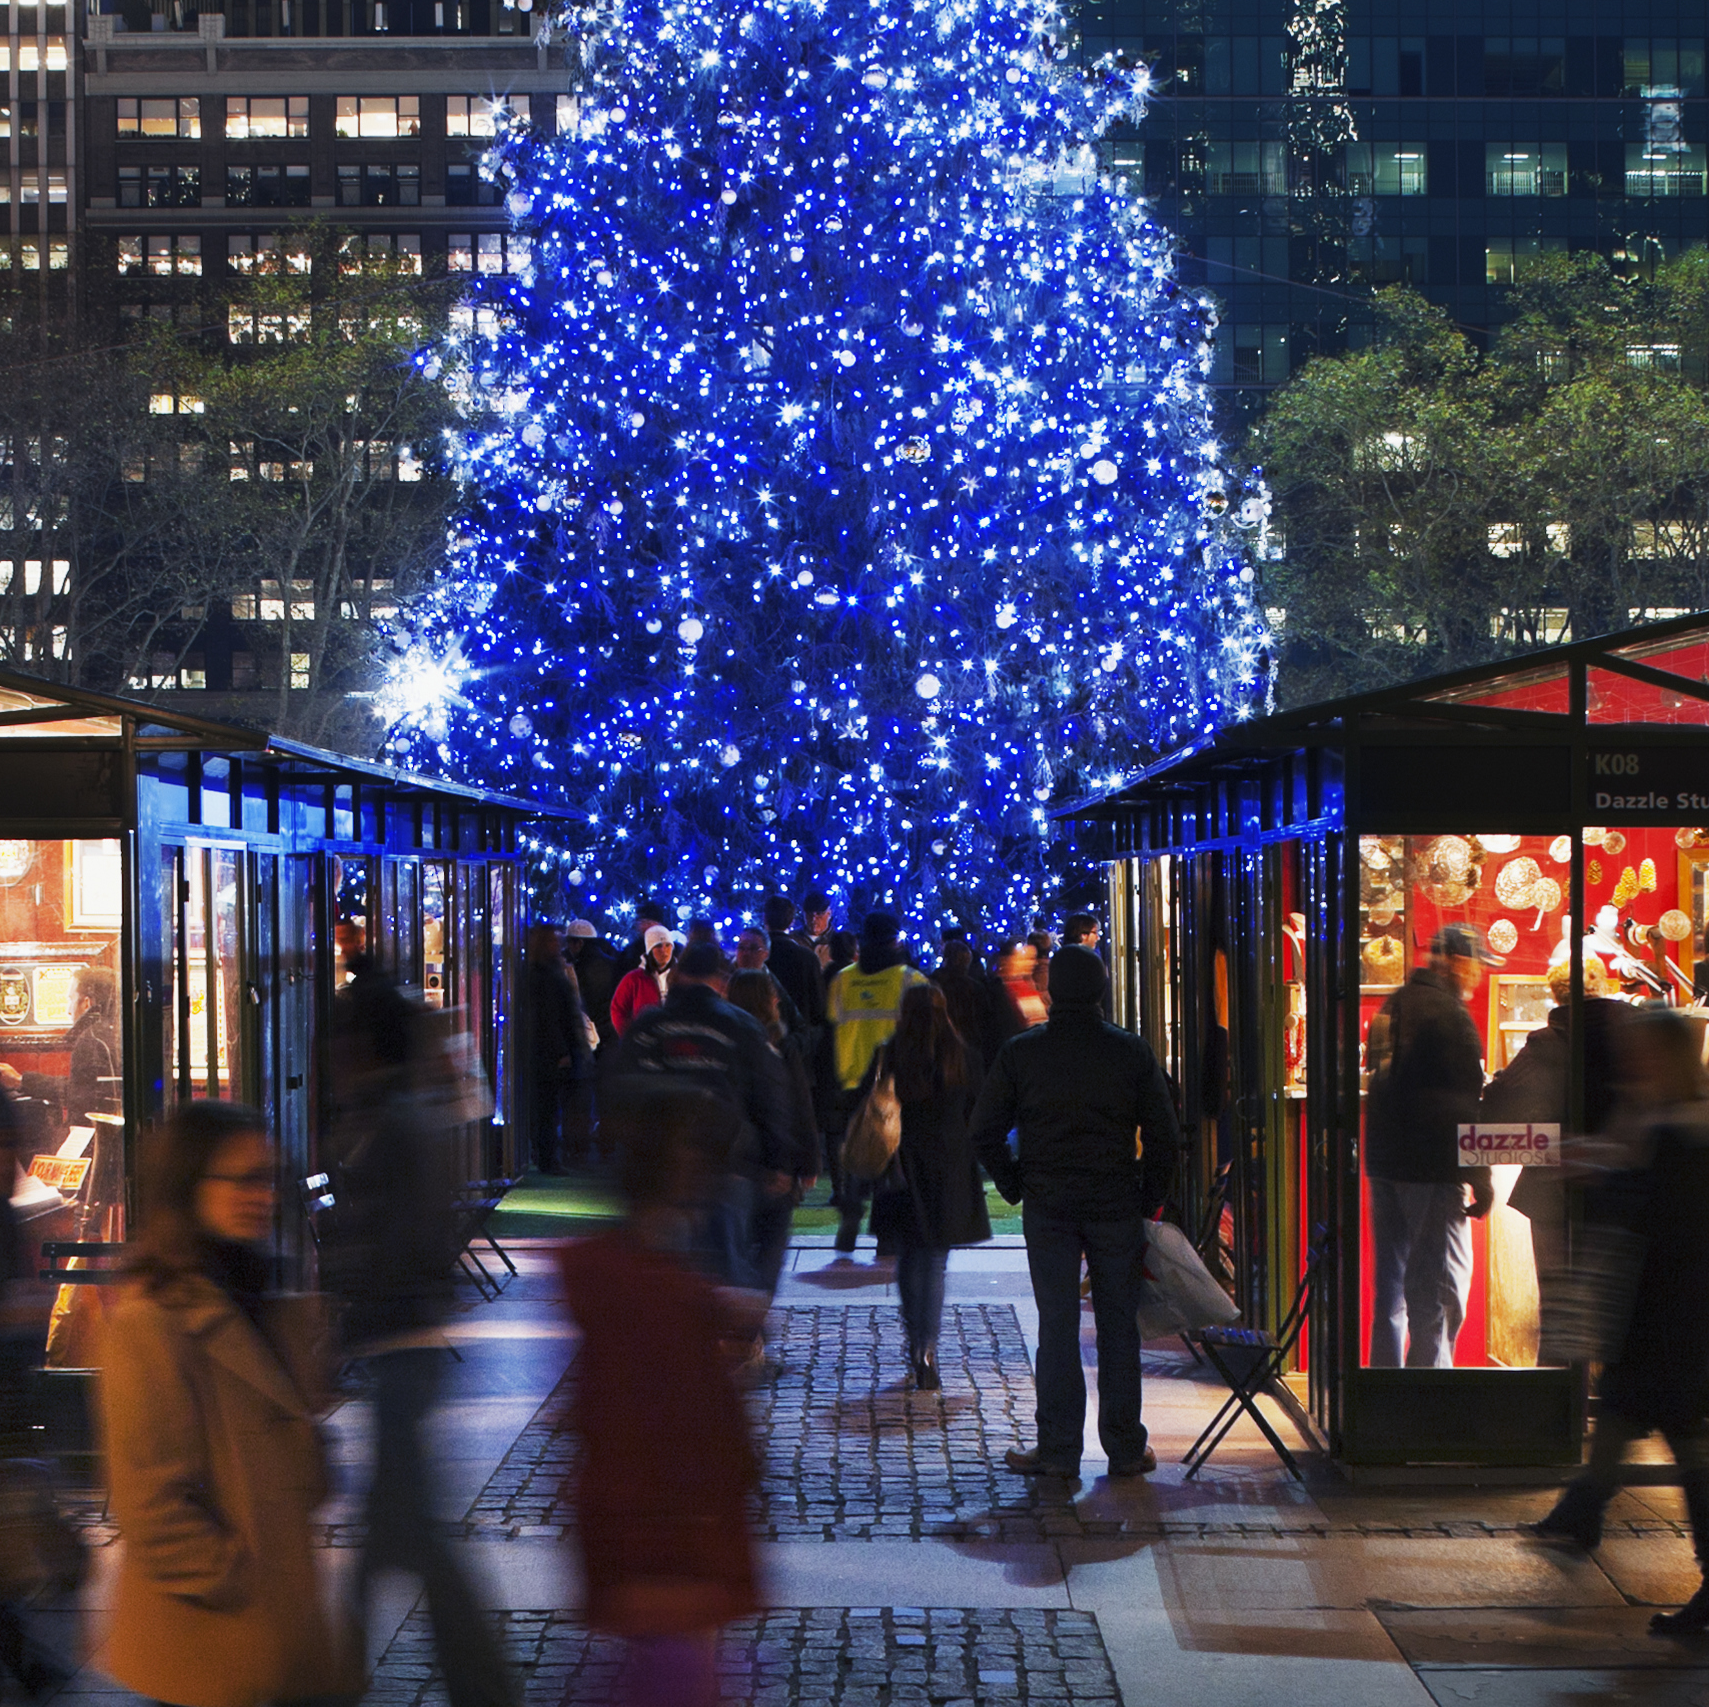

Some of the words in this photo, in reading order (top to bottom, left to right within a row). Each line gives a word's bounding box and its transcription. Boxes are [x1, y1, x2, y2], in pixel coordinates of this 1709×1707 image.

[1595, 753, 1640, 775] K08
[1595, 792, 1669, 809] Dazzle
[1459, 1124, 1549, 1151] dazzle
